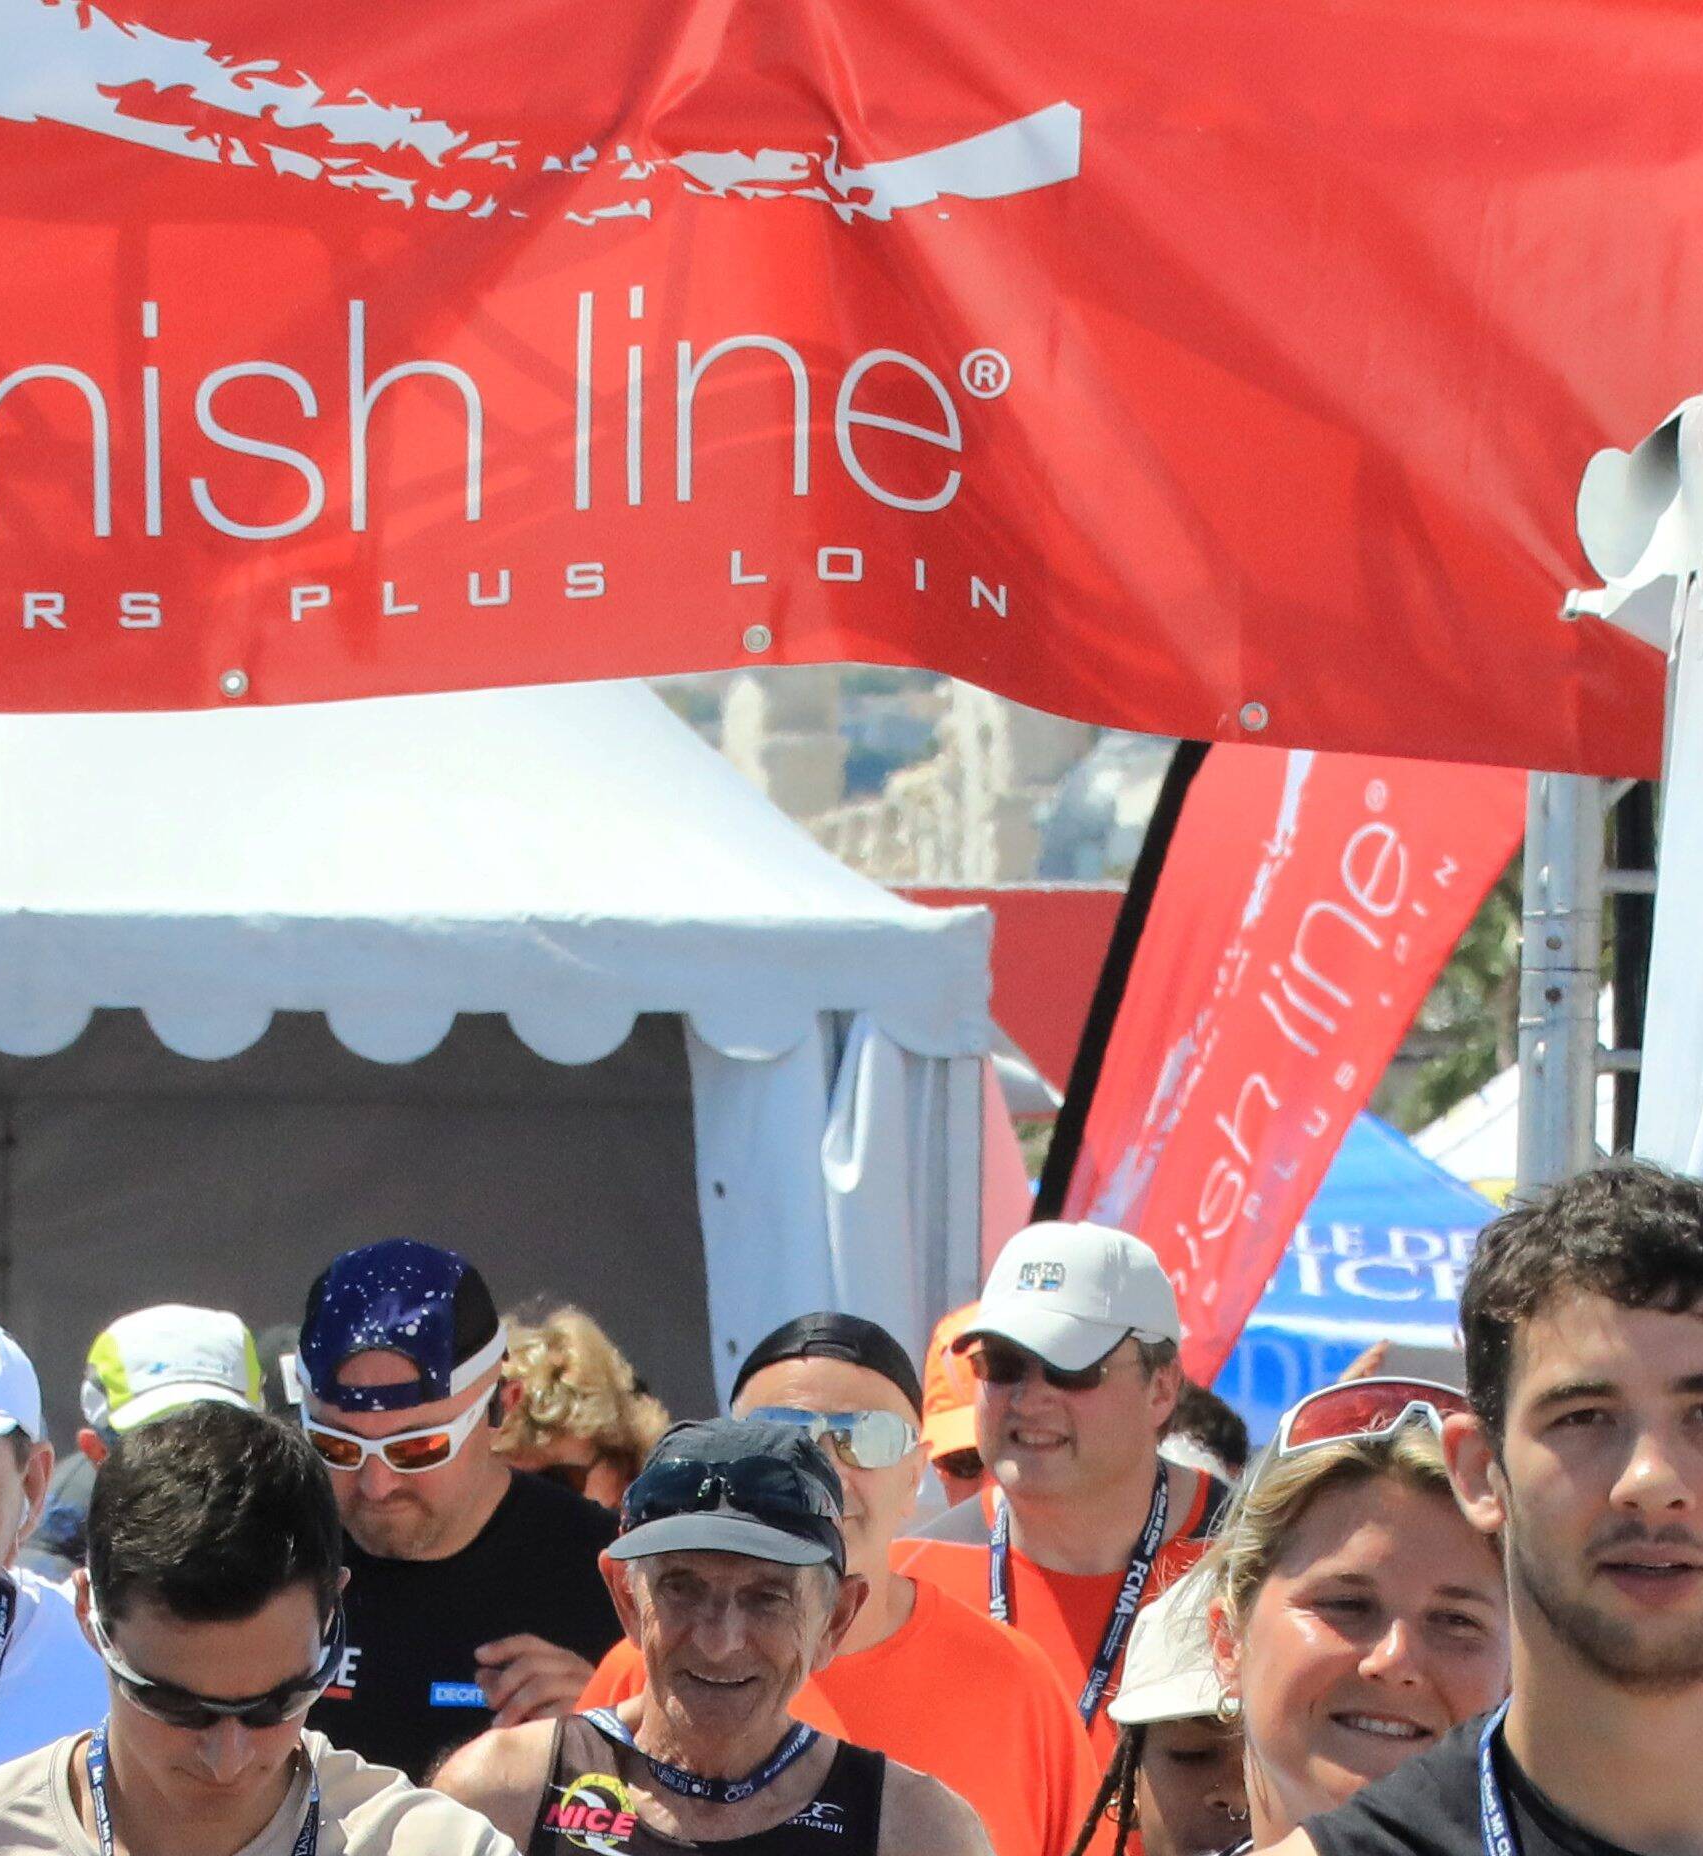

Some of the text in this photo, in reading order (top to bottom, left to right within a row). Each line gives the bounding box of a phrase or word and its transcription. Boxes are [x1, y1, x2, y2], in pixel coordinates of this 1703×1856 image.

[290, 560, 607, 622] PLUS
[729, 543, 1010, 620] LOIN
[1115, 1560, 1148, 1615] FCNA
[544, 1803, 639, 1837] NICE
